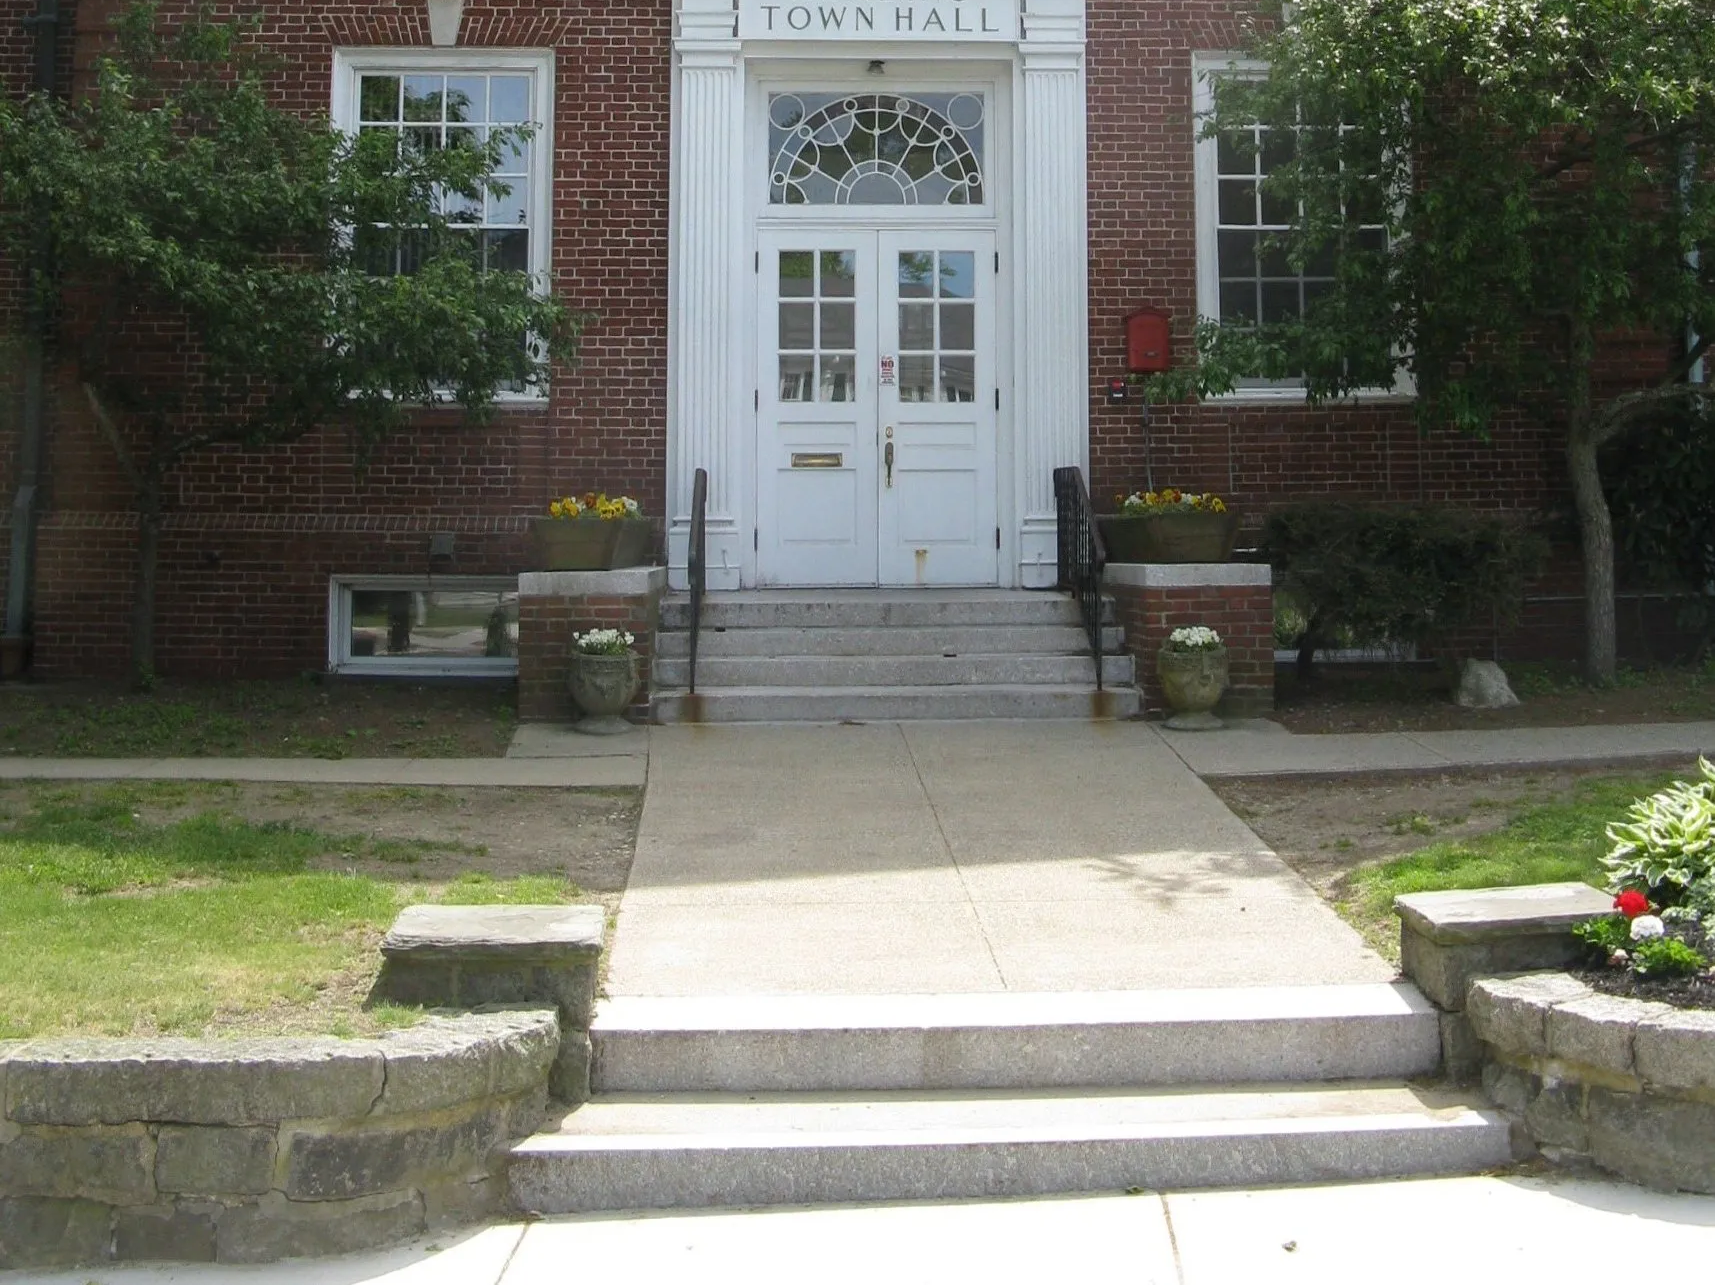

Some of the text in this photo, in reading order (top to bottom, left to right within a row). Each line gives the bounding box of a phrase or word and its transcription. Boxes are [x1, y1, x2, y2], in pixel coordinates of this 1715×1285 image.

[760, 6, 999, 32] TOWN HALL
[881, 360, 894, 368] NO
